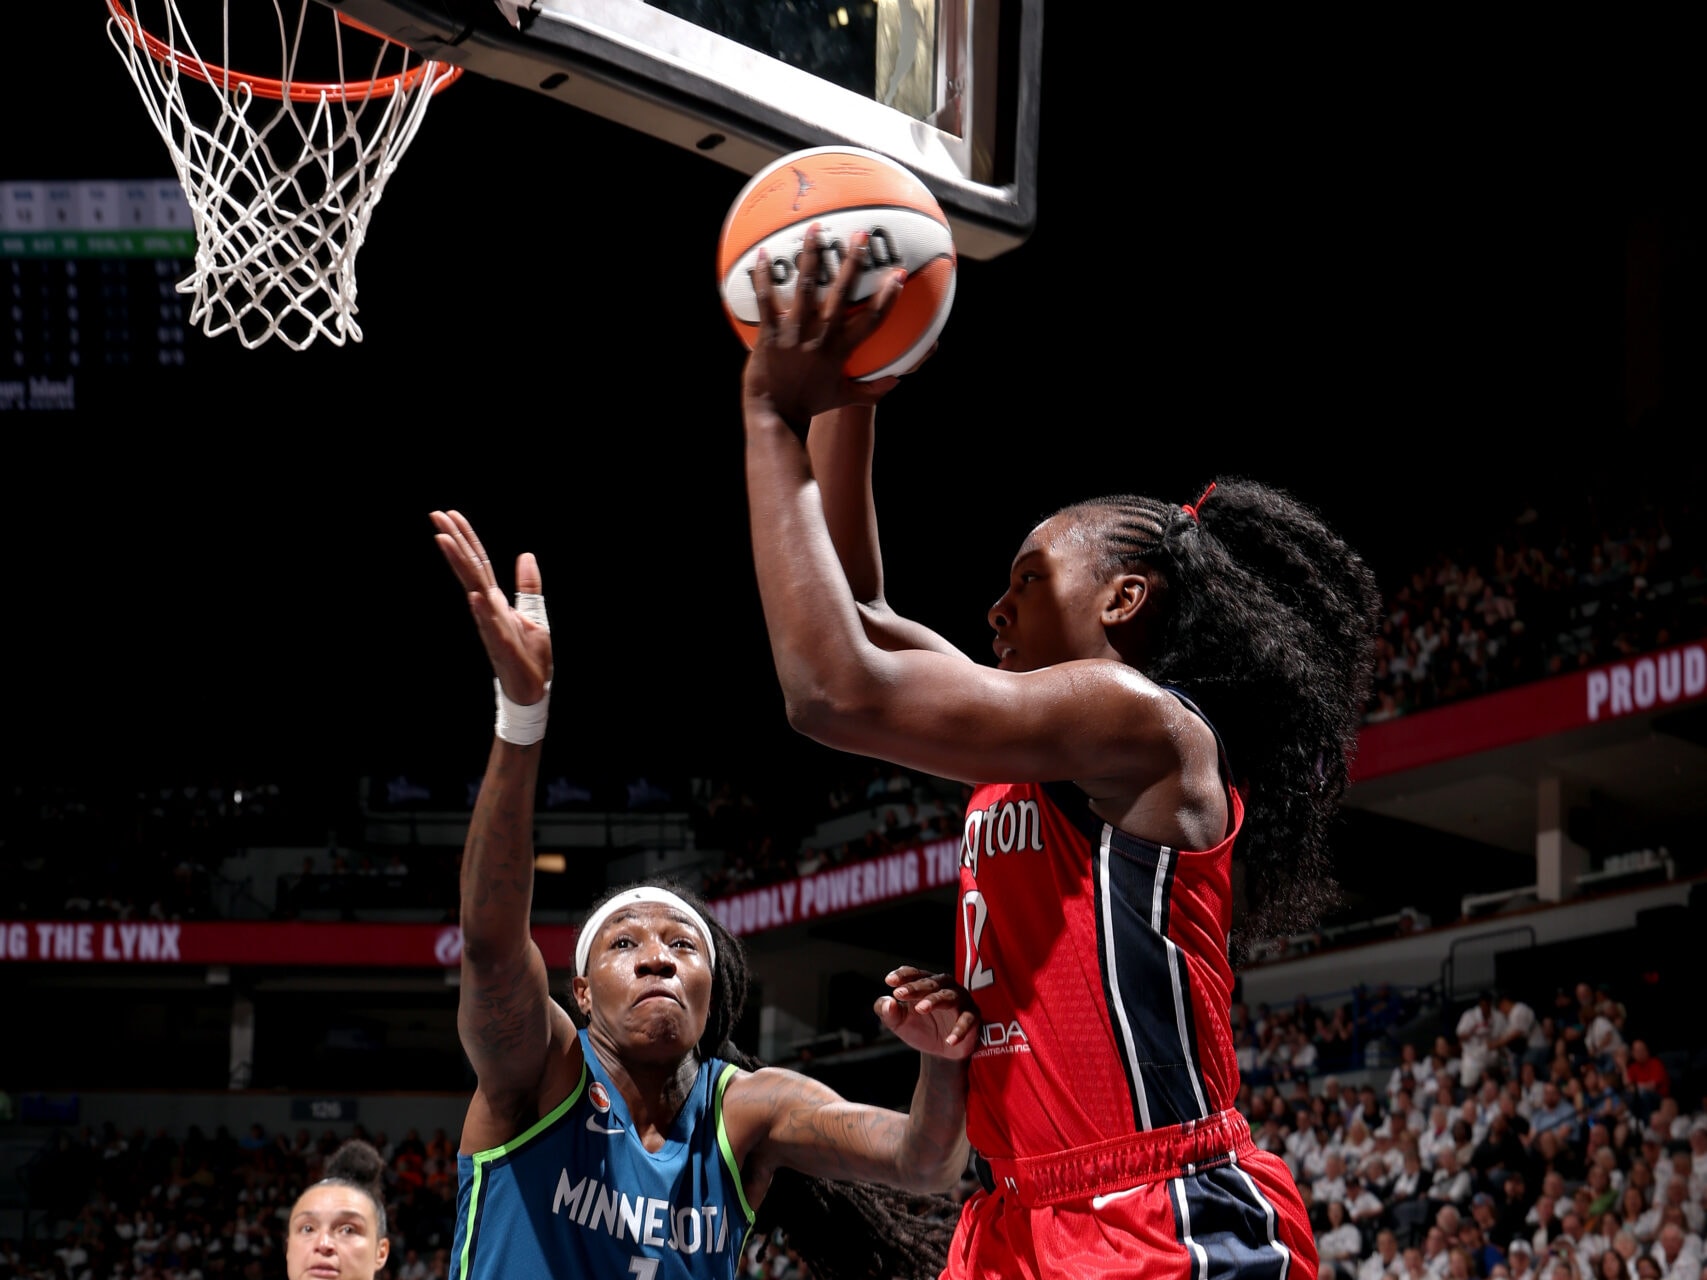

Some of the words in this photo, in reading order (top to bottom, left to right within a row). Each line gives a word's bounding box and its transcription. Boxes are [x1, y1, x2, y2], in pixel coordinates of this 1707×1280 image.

[1587, 645, 1706, 721] PROUD
[958, 799, 1045, 878] gton
[801, 852, 919, 919] POWERING
[36, 922, 95, 961] THE
[103, 922, 181, 961] LYNX
